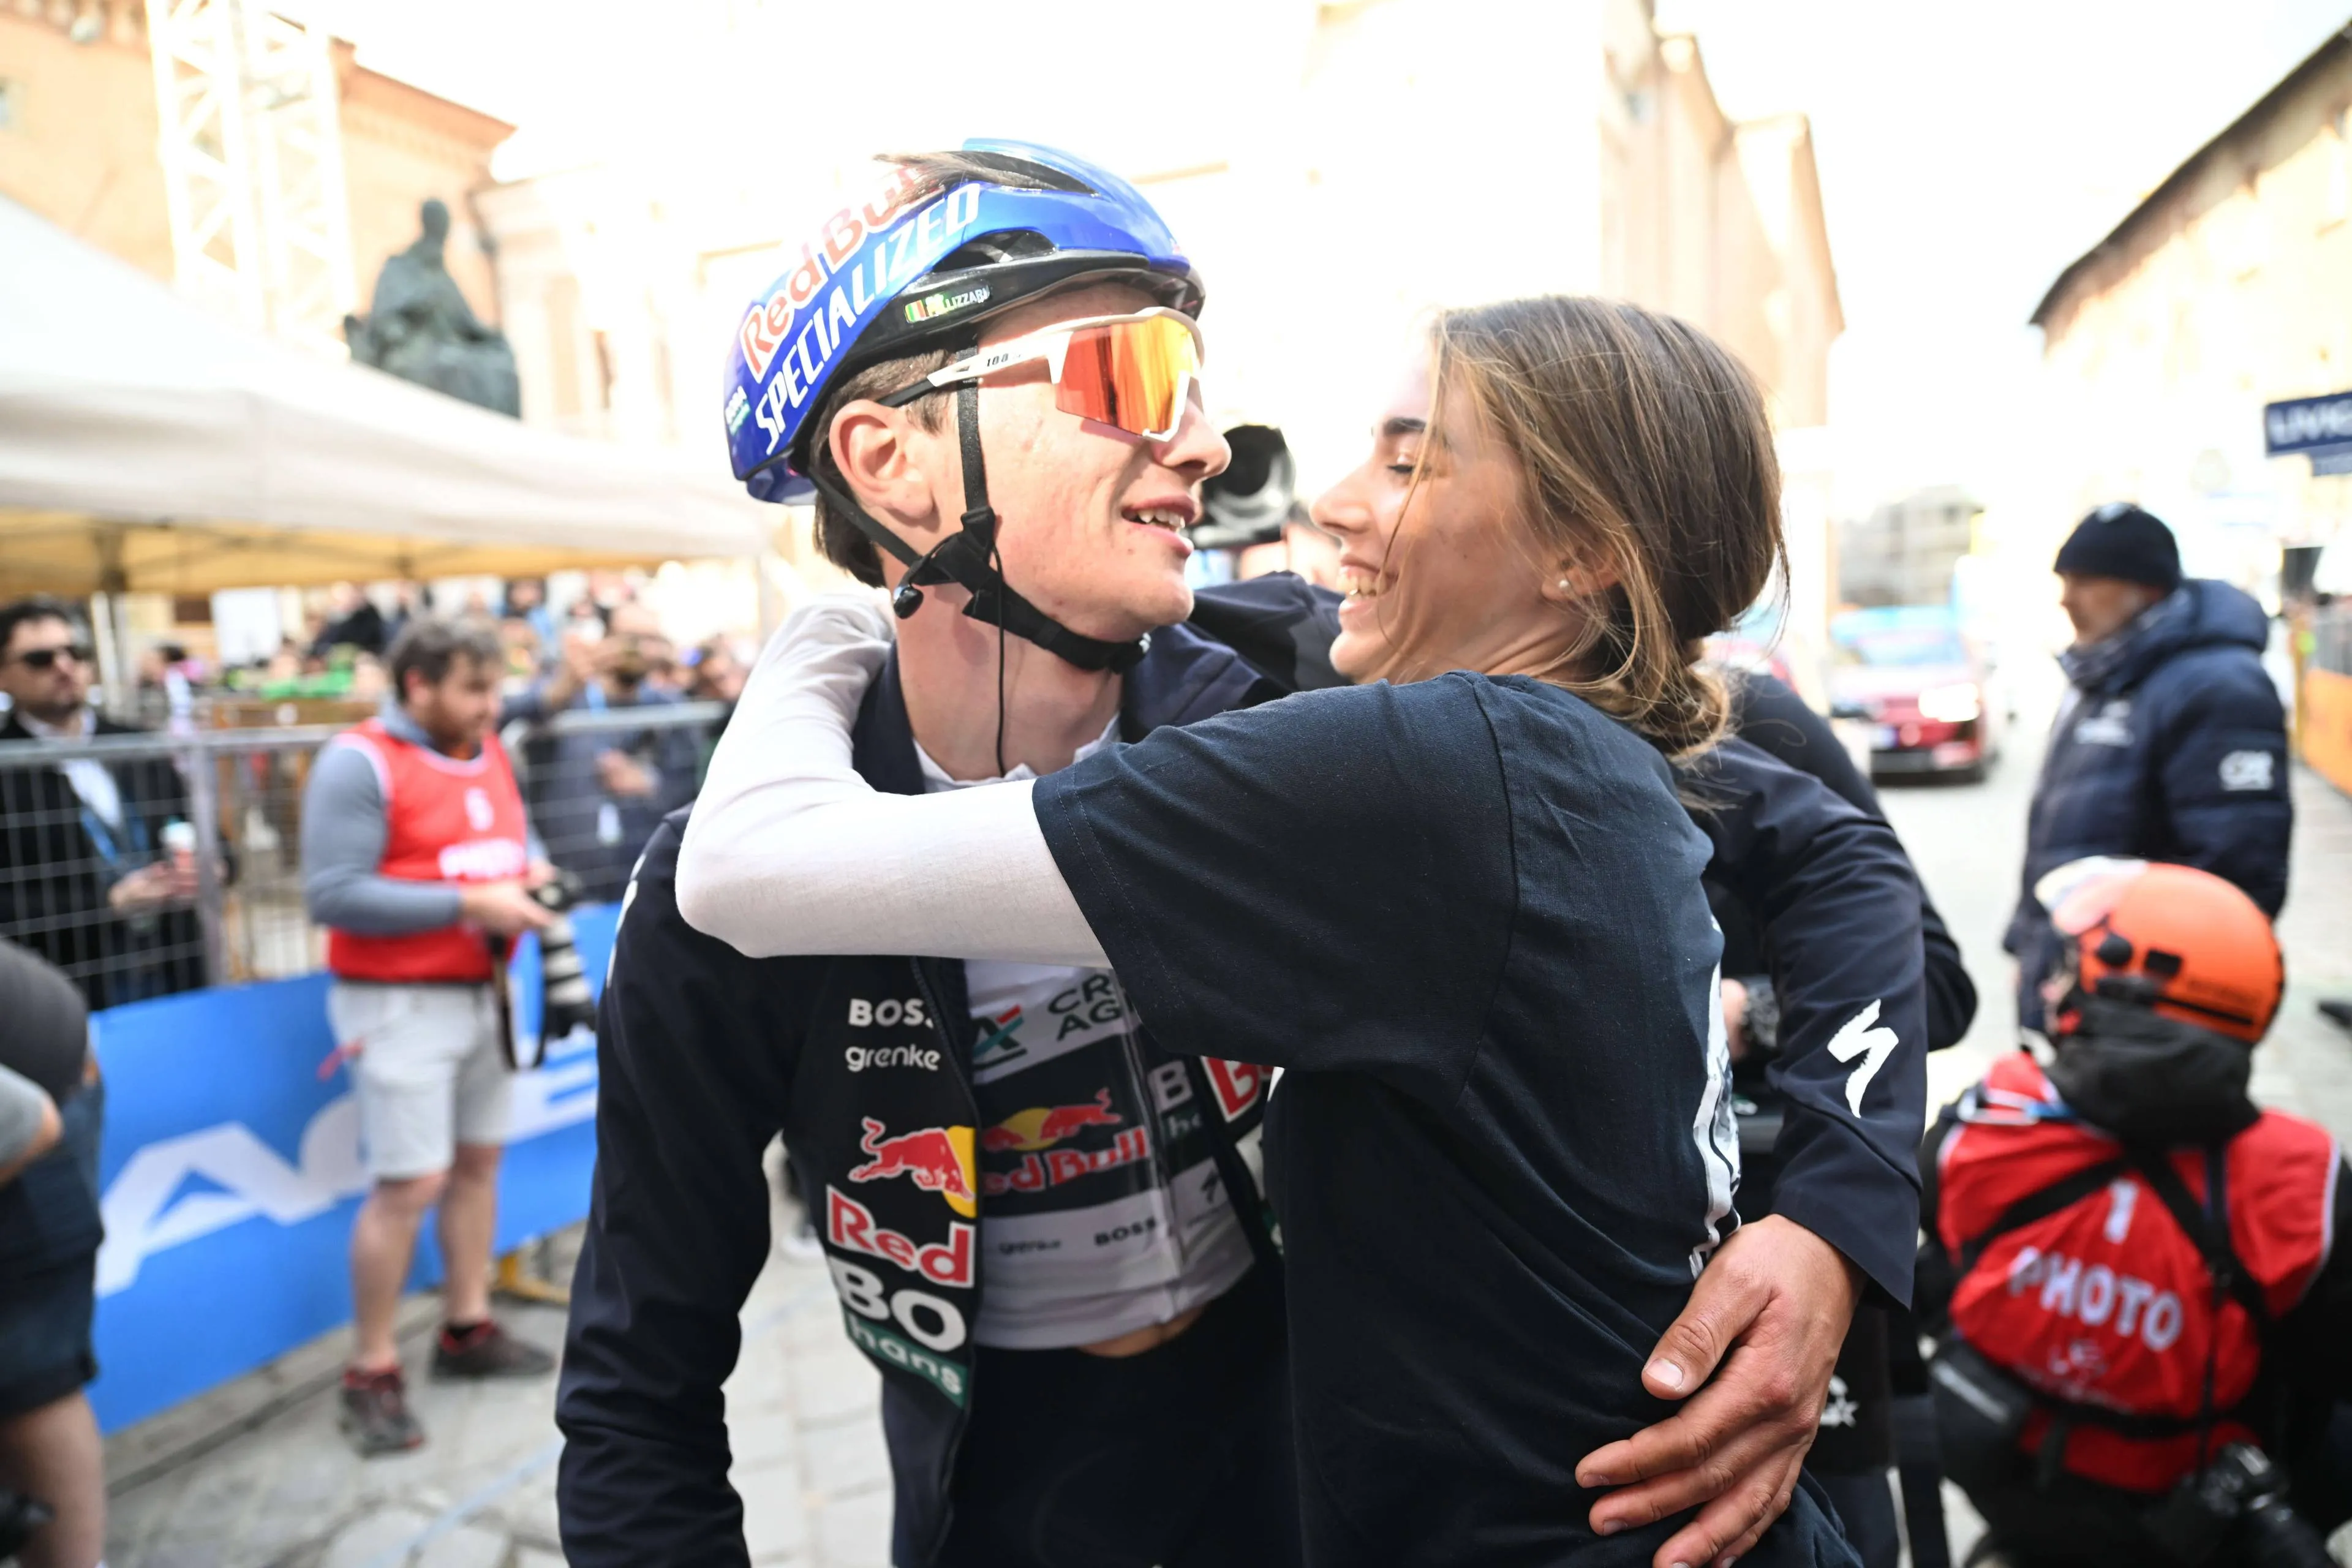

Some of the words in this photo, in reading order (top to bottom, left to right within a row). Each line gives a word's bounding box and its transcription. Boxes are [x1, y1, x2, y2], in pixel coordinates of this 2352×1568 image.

[741, 241, 828, 383] Red
[755, 183, 981, 455] SPECIALIZED
[845, 1044, 941, 1072] grenke
[848, 998, 934, 1029] BOS
[826, 1183, 976, 1289] Red
[2008, 1246, 2182, 1350] PHOTO
